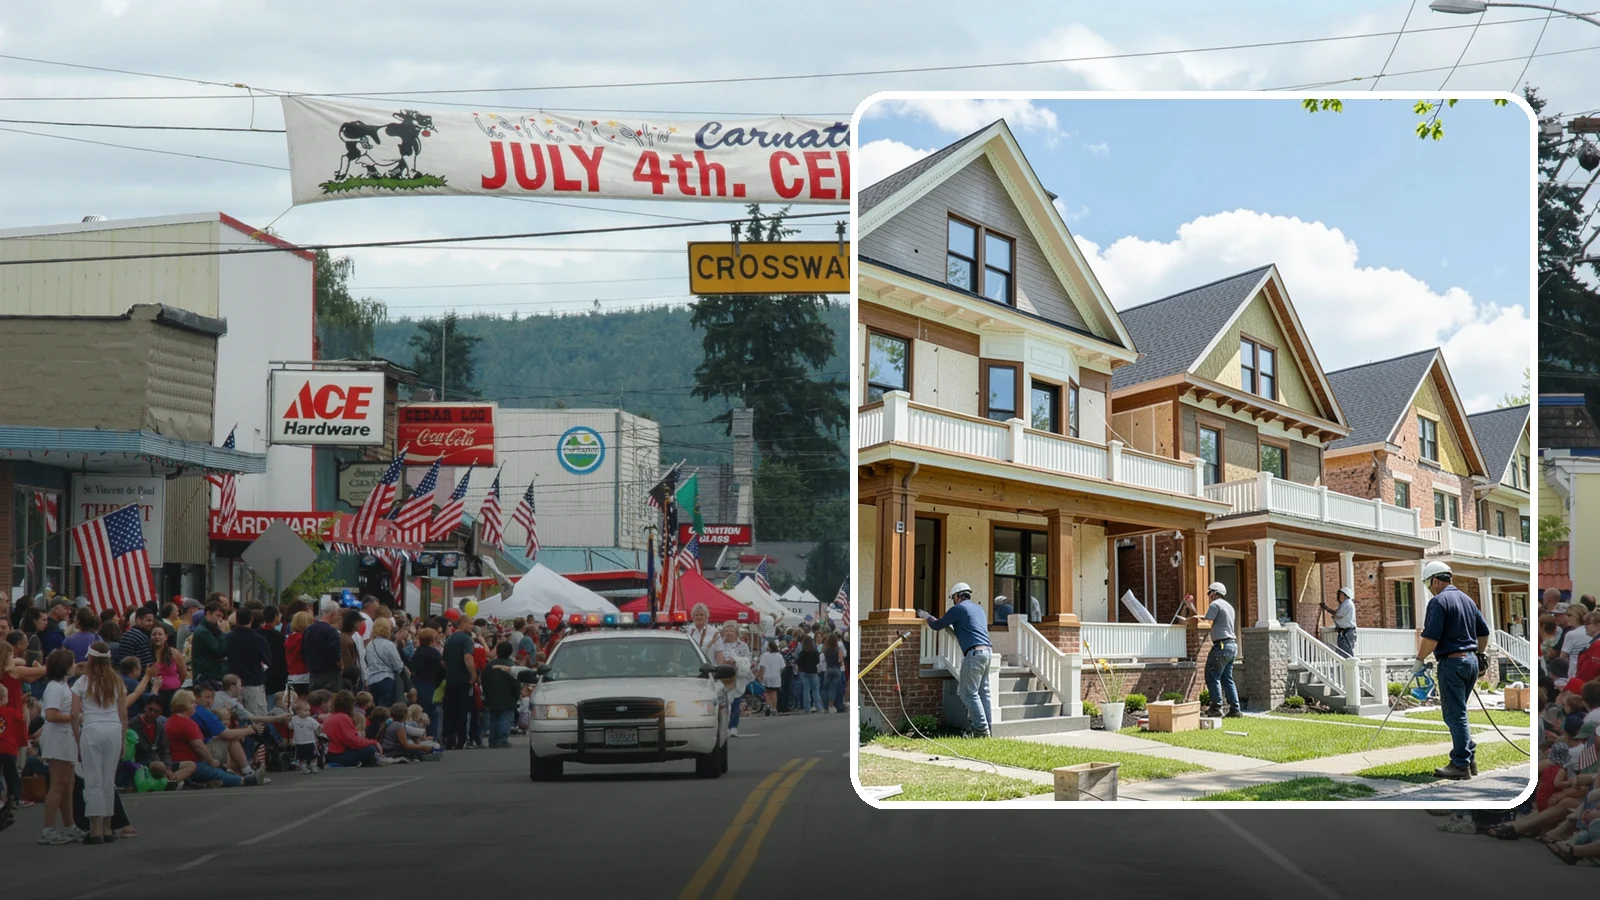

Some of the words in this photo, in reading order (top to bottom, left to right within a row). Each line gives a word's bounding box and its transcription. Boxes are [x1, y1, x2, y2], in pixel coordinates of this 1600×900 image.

[481, 140, 605, 192] JULY
[632, 150, 746, 198] 4th.
[697, 254, 850, 280] CROSSWA
[282, 380, 374, 420] ACE
[405, 409, 452, 422] CEDAR
[461, 409, 485, 422] LOG
[283, 421, 371, 436] Hardware
[416, 428, 477, 447] Coca-Cola
[353, 466, 385, 479] Simpl
[95, 485, 124, 495] Vincent
[126, 485, 136, 495] de
[137, 486, 155, 495] Paul
[80, 503, 154, 522] THT
[688, 526, 741, 535] CRNATION
[699, 535, 730, 543] GLASS
